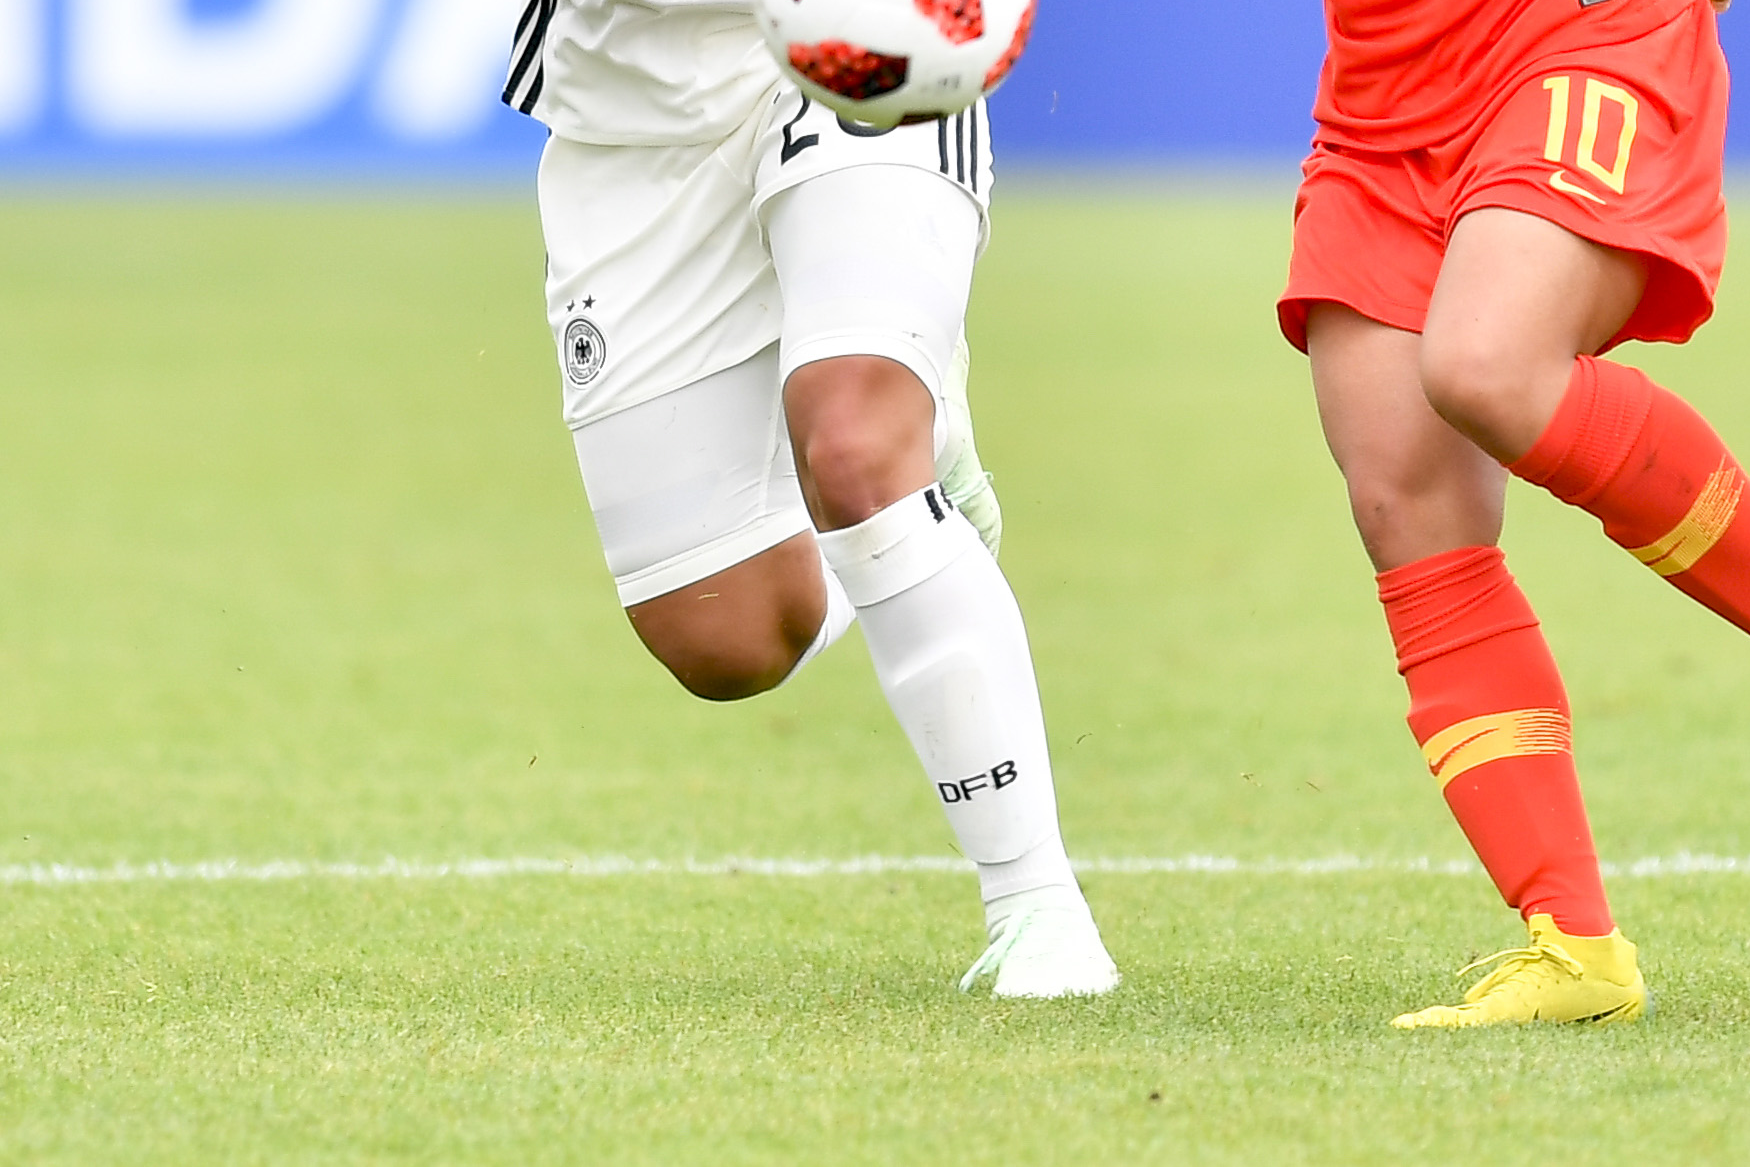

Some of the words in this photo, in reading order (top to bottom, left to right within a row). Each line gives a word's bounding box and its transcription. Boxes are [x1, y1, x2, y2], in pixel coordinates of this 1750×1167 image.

[773, 91, 899, 166] 2
[1543, 75, 1639, 195] 10
[938, 760, 1018, 803] DFB
